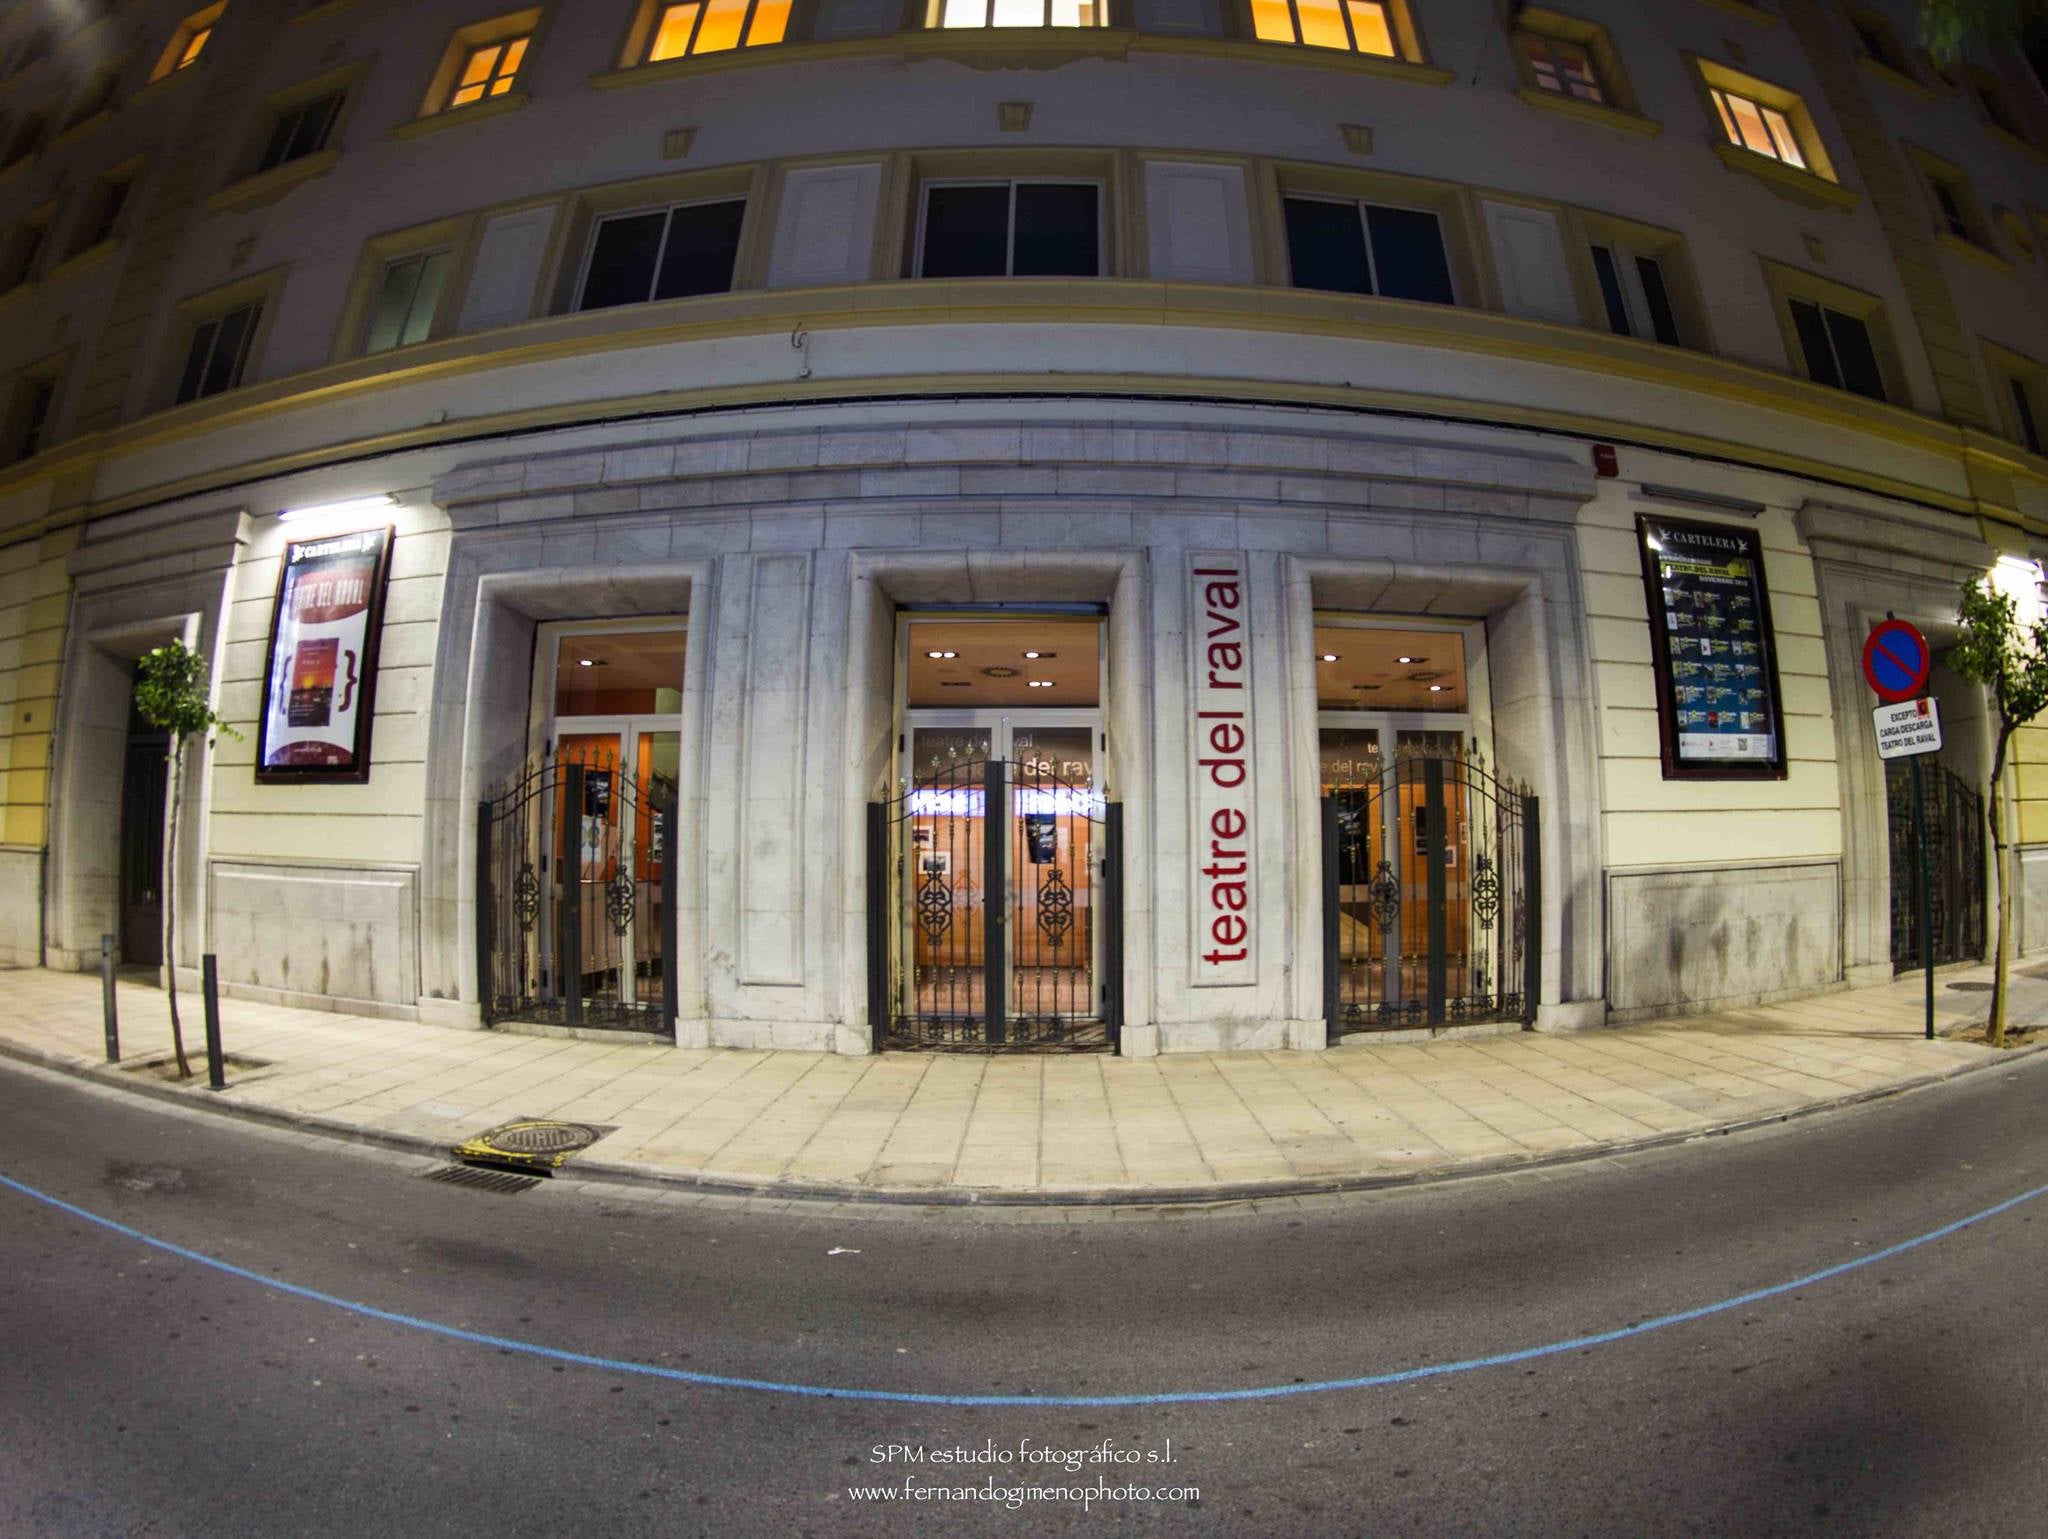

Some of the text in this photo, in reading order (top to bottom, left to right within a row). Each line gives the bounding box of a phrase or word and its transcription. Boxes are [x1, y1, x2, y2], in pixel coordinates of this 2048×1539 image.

[1673, 532, 1736, 549] CARTELERA
[317, 581, 333, 607] DEL
[1891, 710, 1917, 722] EXCEPTO
[1880, 720, 1933, 737] CARGA DESCARGA
[1881, 734, 1936, 750] TEATRO DEL RAVAL
[1193, 568, 1247, 966] teatre del raval
